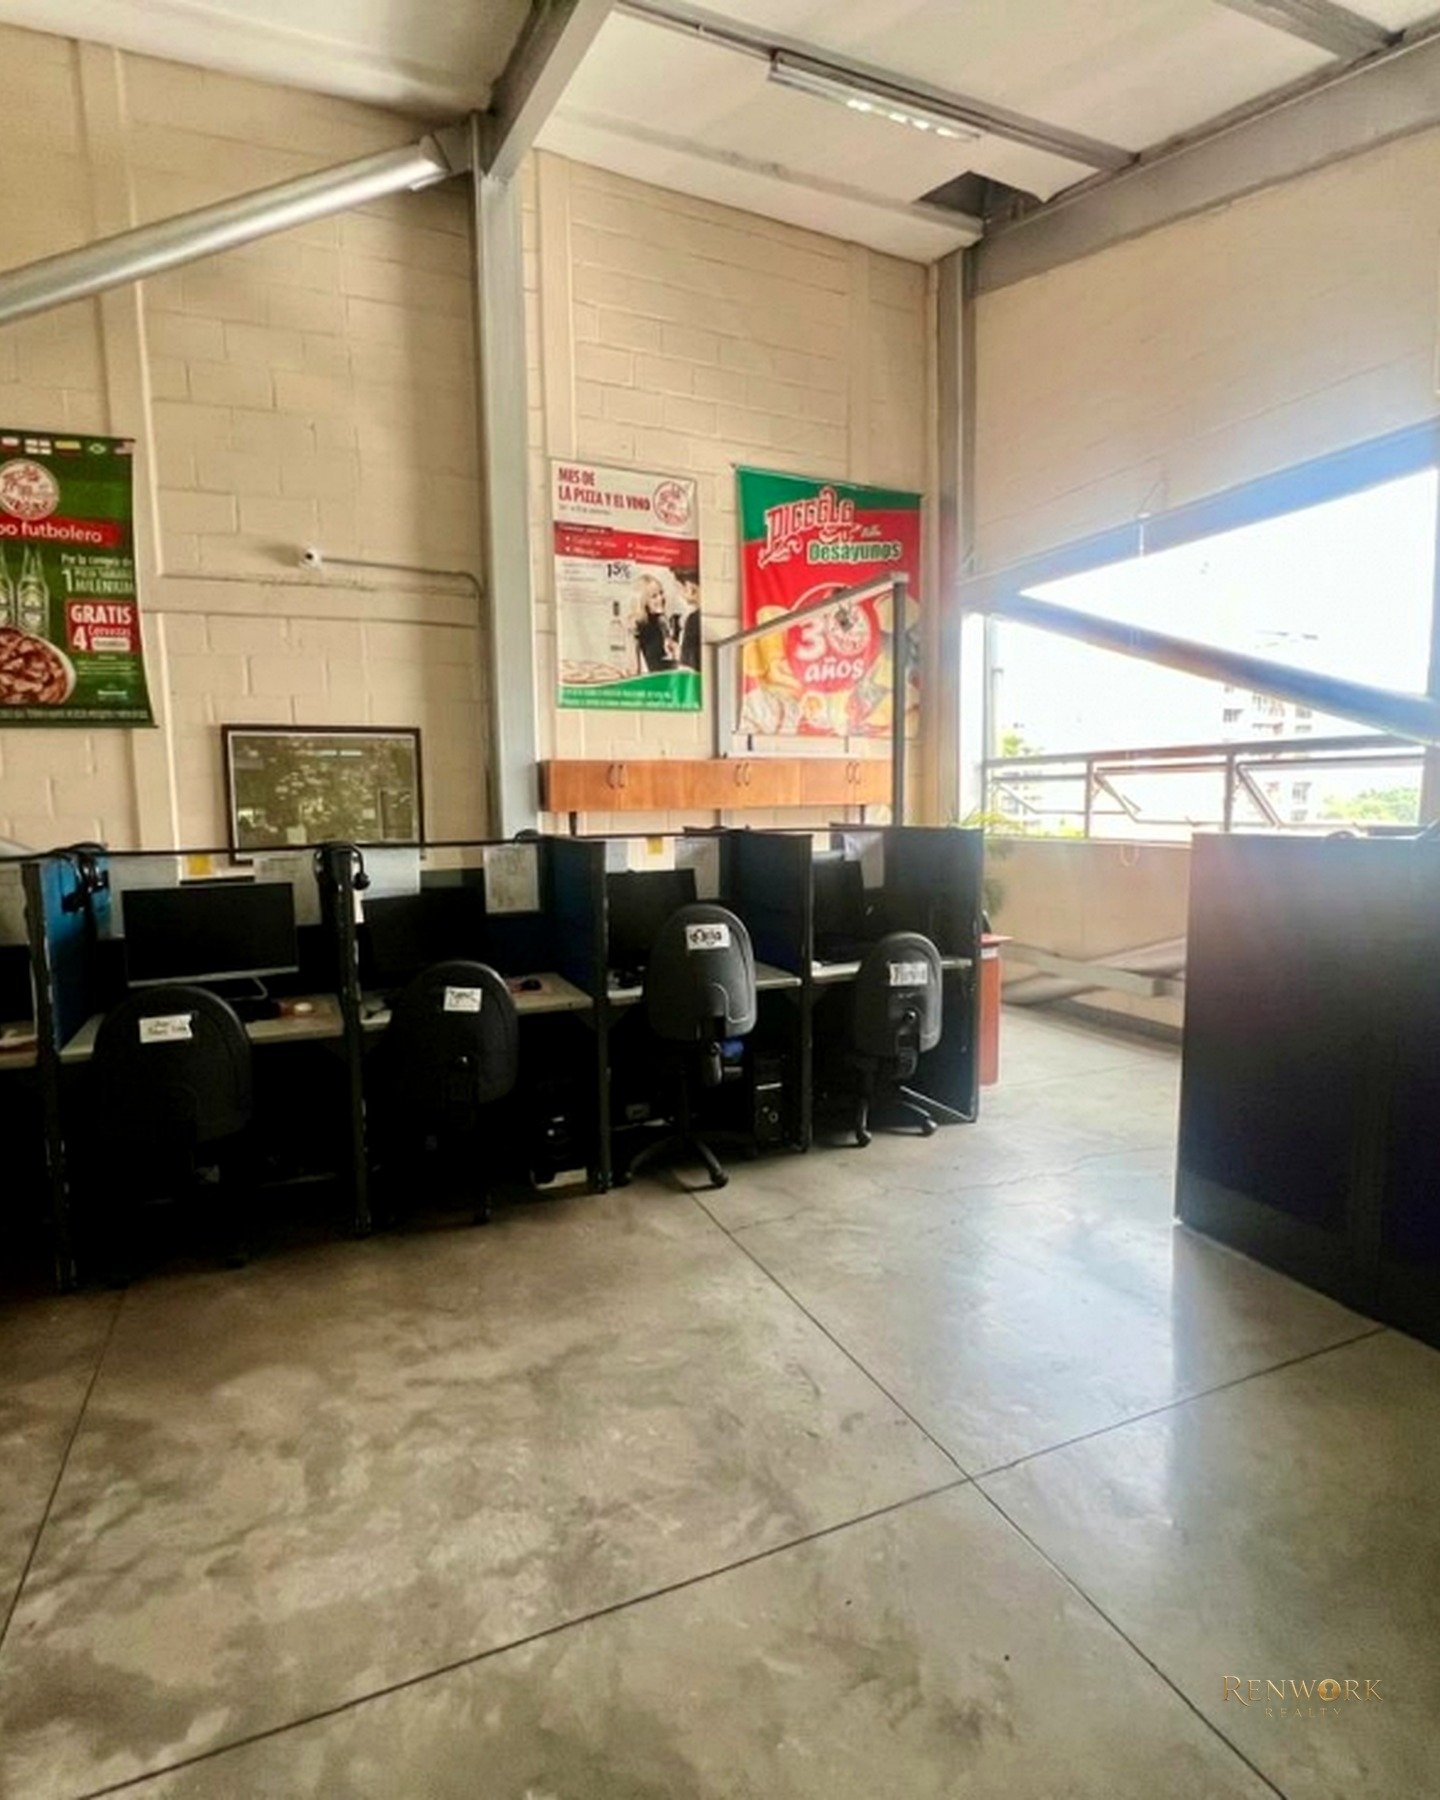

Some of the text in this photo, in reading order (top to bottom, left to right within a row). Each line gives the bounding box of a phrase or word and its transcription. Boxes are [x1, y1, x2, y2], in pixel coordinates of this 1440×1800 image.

[559, 468, 595, 486] MES DE
[559, 486, 572, 501] LA
[574, 488, 602, 505] PIZZA
[603, 493, 612, 506] Y
[613, 494, 626, 508] EL
[627, 495, 651, 511] VINO
[21, 521, 102, 543] futbolero
[808, 541, 902, 564] Desayunos
[71, 604, 132, 625] GRATIS
[73, 626, 88, 650] 4
[804, 656, 864, 682] años
